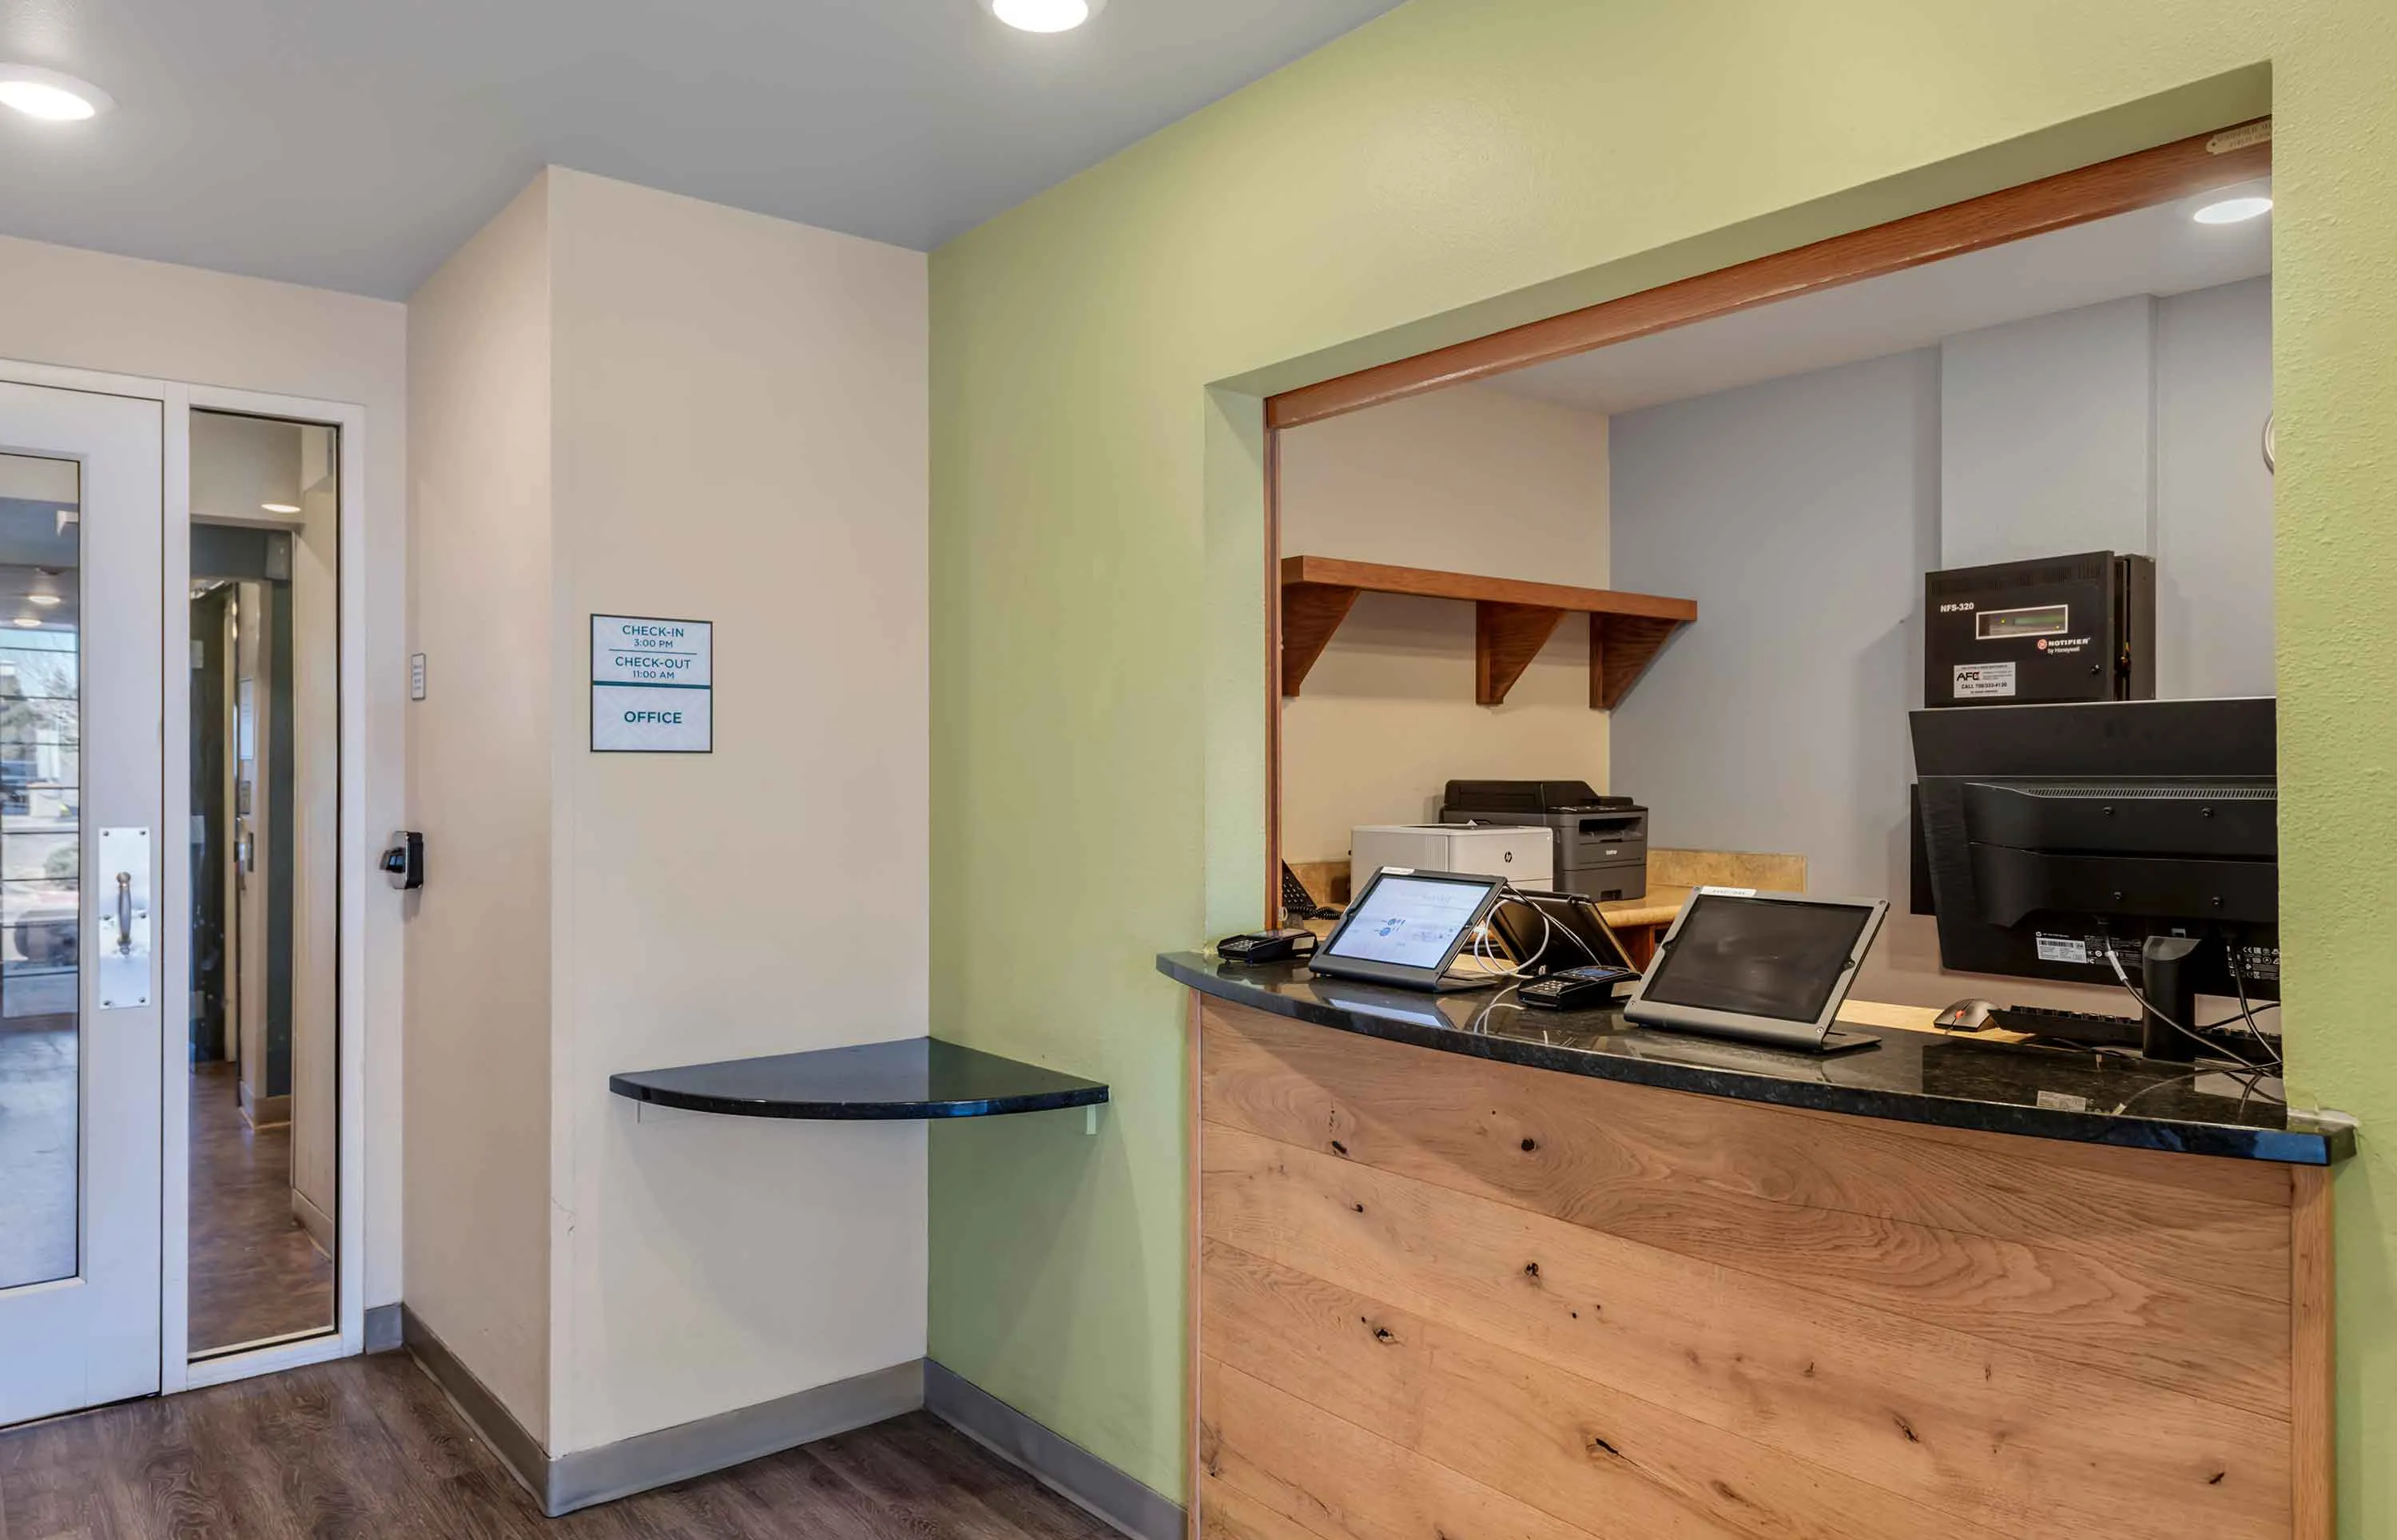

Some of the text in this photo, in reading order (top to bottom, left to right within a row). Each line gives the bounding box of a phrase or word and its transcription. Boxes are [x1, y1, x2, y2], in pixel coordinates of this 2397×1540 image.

[1940, 602, 1974, 613] NFS-320
[622, 625, 684, 637] CHECK-IN
[634, 639, 674, 649] 3:00 PM
[615, 657, 691, 669] CHECK-OUT
[624, 711, 682, 724] OFFICE
